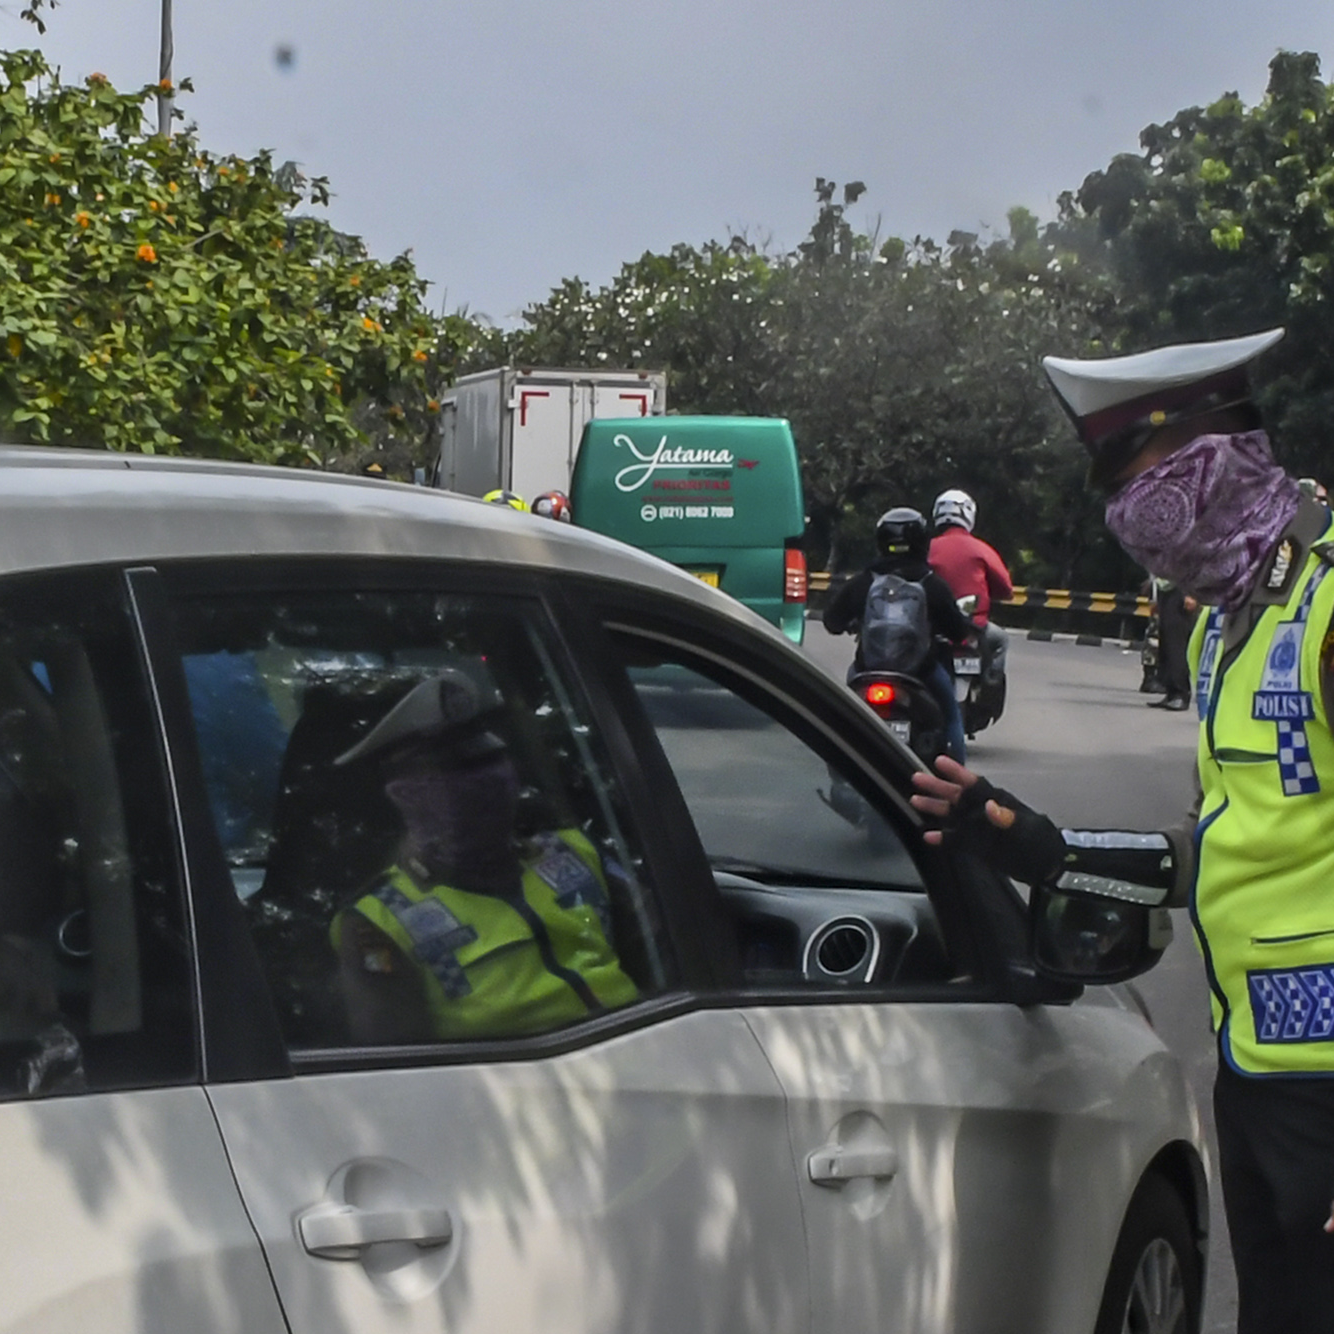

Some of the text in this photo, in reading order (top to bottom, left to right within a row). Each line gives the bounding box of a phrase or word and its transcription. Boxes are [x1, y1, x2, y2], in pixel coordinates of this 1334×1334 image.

[613, 433, 734, 492] Yatama
[653, 479, 731, 490] PRIORITAS
[1255, 695, 1309, 717] POLISI
